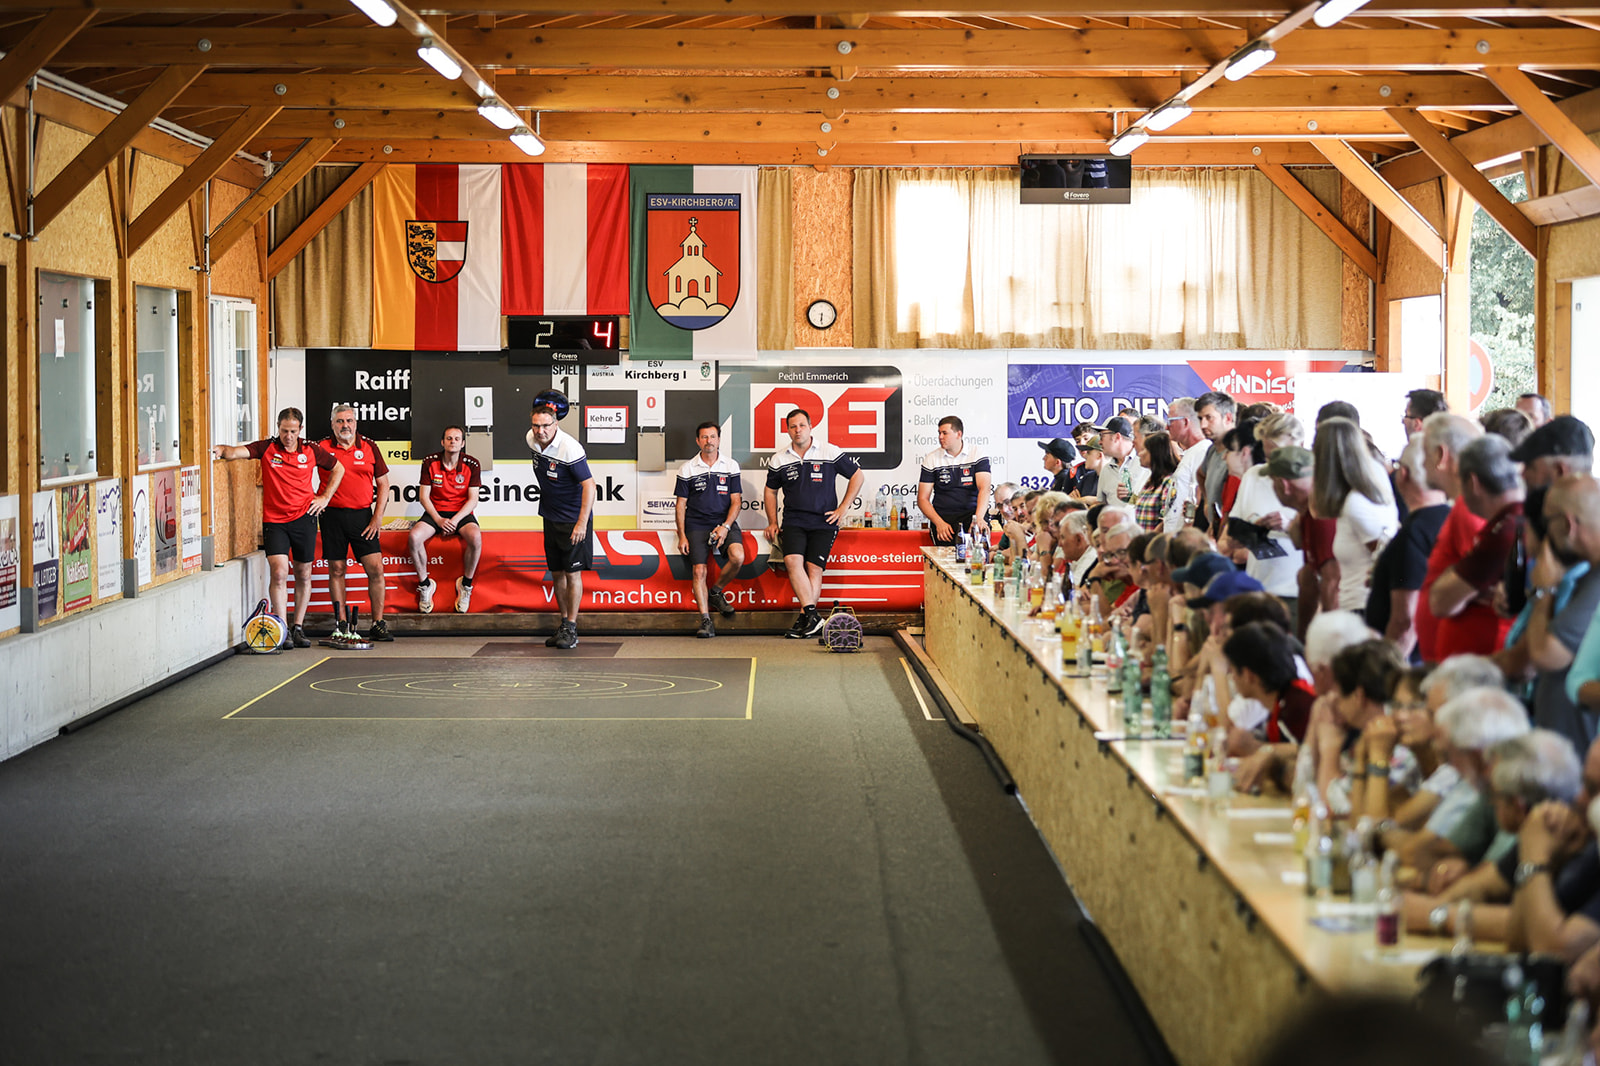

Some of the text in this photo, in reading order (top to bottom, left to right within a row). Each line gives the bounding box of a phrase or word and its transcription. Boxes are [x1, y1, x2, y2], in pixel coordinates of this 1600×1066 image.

[650, 197, 737, 207] ESV-KIRCHBERG/R.
[535, 321, 613, 348] 2 4
[552, 364, 578, 375] SPIEL
[647, 360, 664, 368] ESV
[355, 369, 410, 390] Raiff
[625, 370, 679, 381] Kirchberg
[778, 372, 848, 381] Pechtl Emmerich
[914, 373, 994, 389] Überdachungen
[473, 395, 484, 408] 0
[646, 396, 657, 409] 0
[913, 394, 959, 406] Geländer
[590, 412, 622, 422] Kehre 5
[1018, 397, 1170, 426] AUTO DIEN
[914, 414, 939, 426] Balko
[388, 448, 411, 461] reg
[478, 476, 541, 503] eine
[1021, 476, 1055, 491] 832
[647, 500, 676, 508] SEIWA
[592, 584, 682, 604] machen
